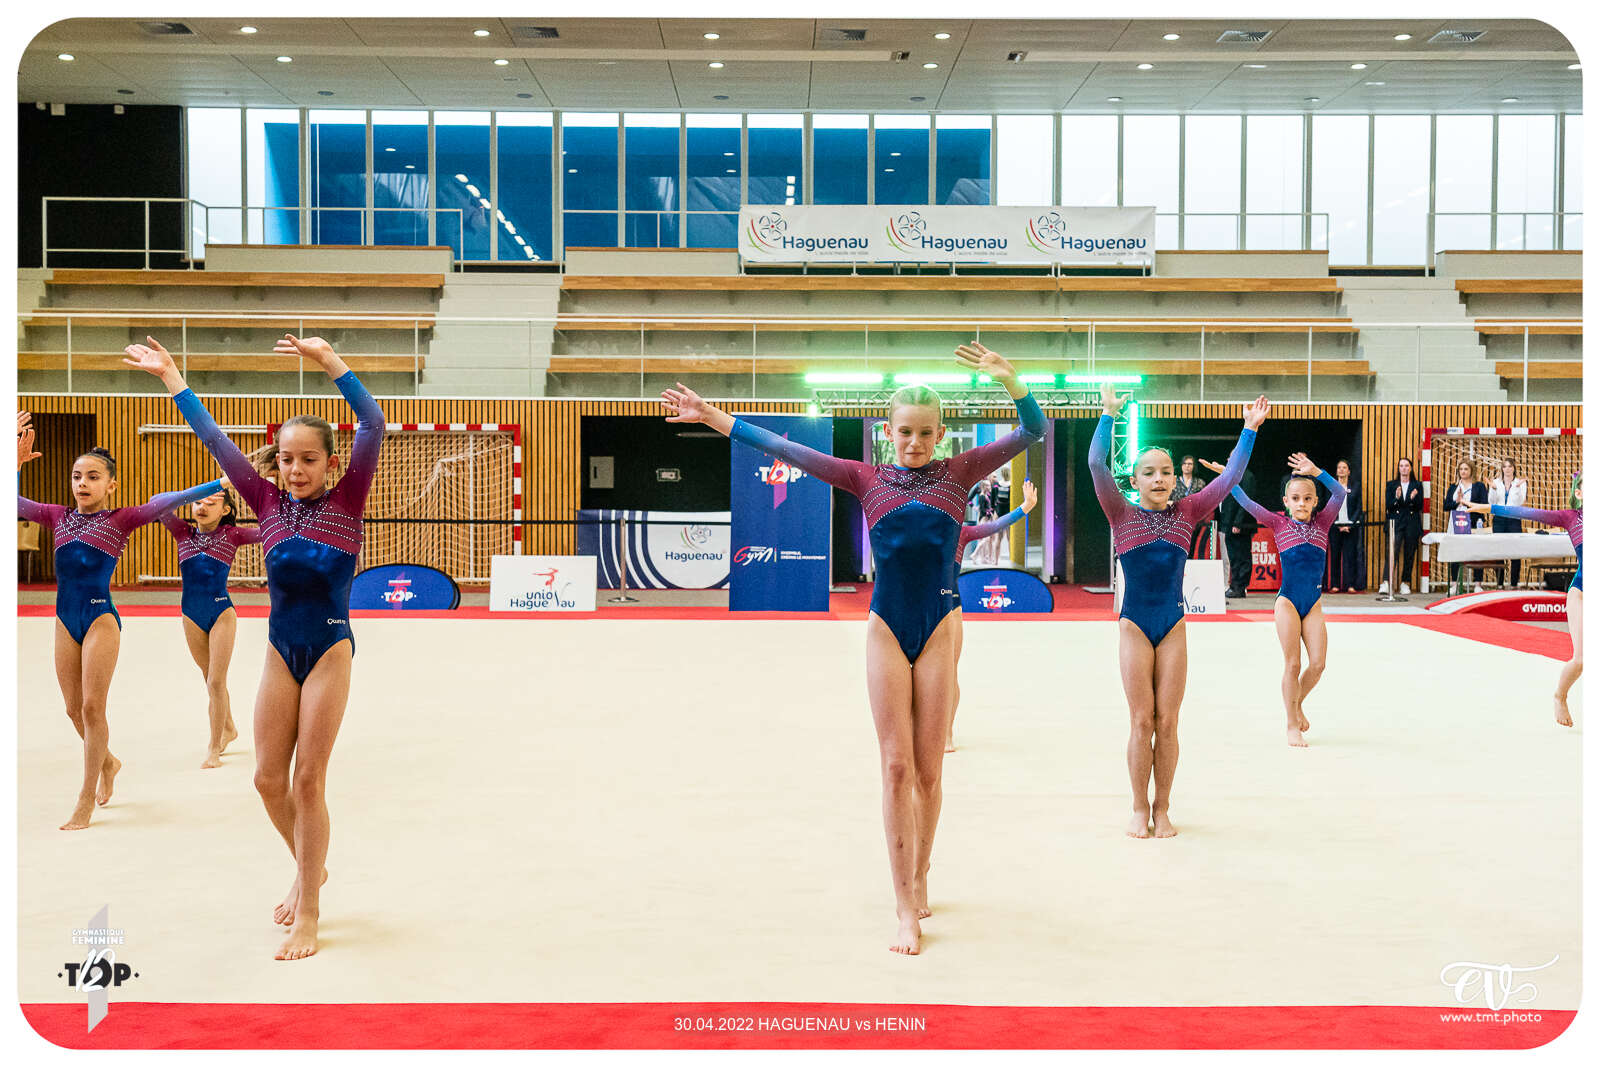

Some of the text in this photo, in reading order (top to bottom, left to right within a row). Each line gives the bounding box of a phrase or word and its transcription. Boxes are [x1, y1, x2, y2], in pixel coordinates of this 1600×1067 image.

[783, 236, 869, 251] Haguenau
[921, 235, 1008, 252] Haguenau
[1061, 236, 1146, 253] Haguenau
[759, 464, 802, 483] TOP
[665, 551, 723, 562] Haguenau
[1252, 553, 1276, 565] EUX
